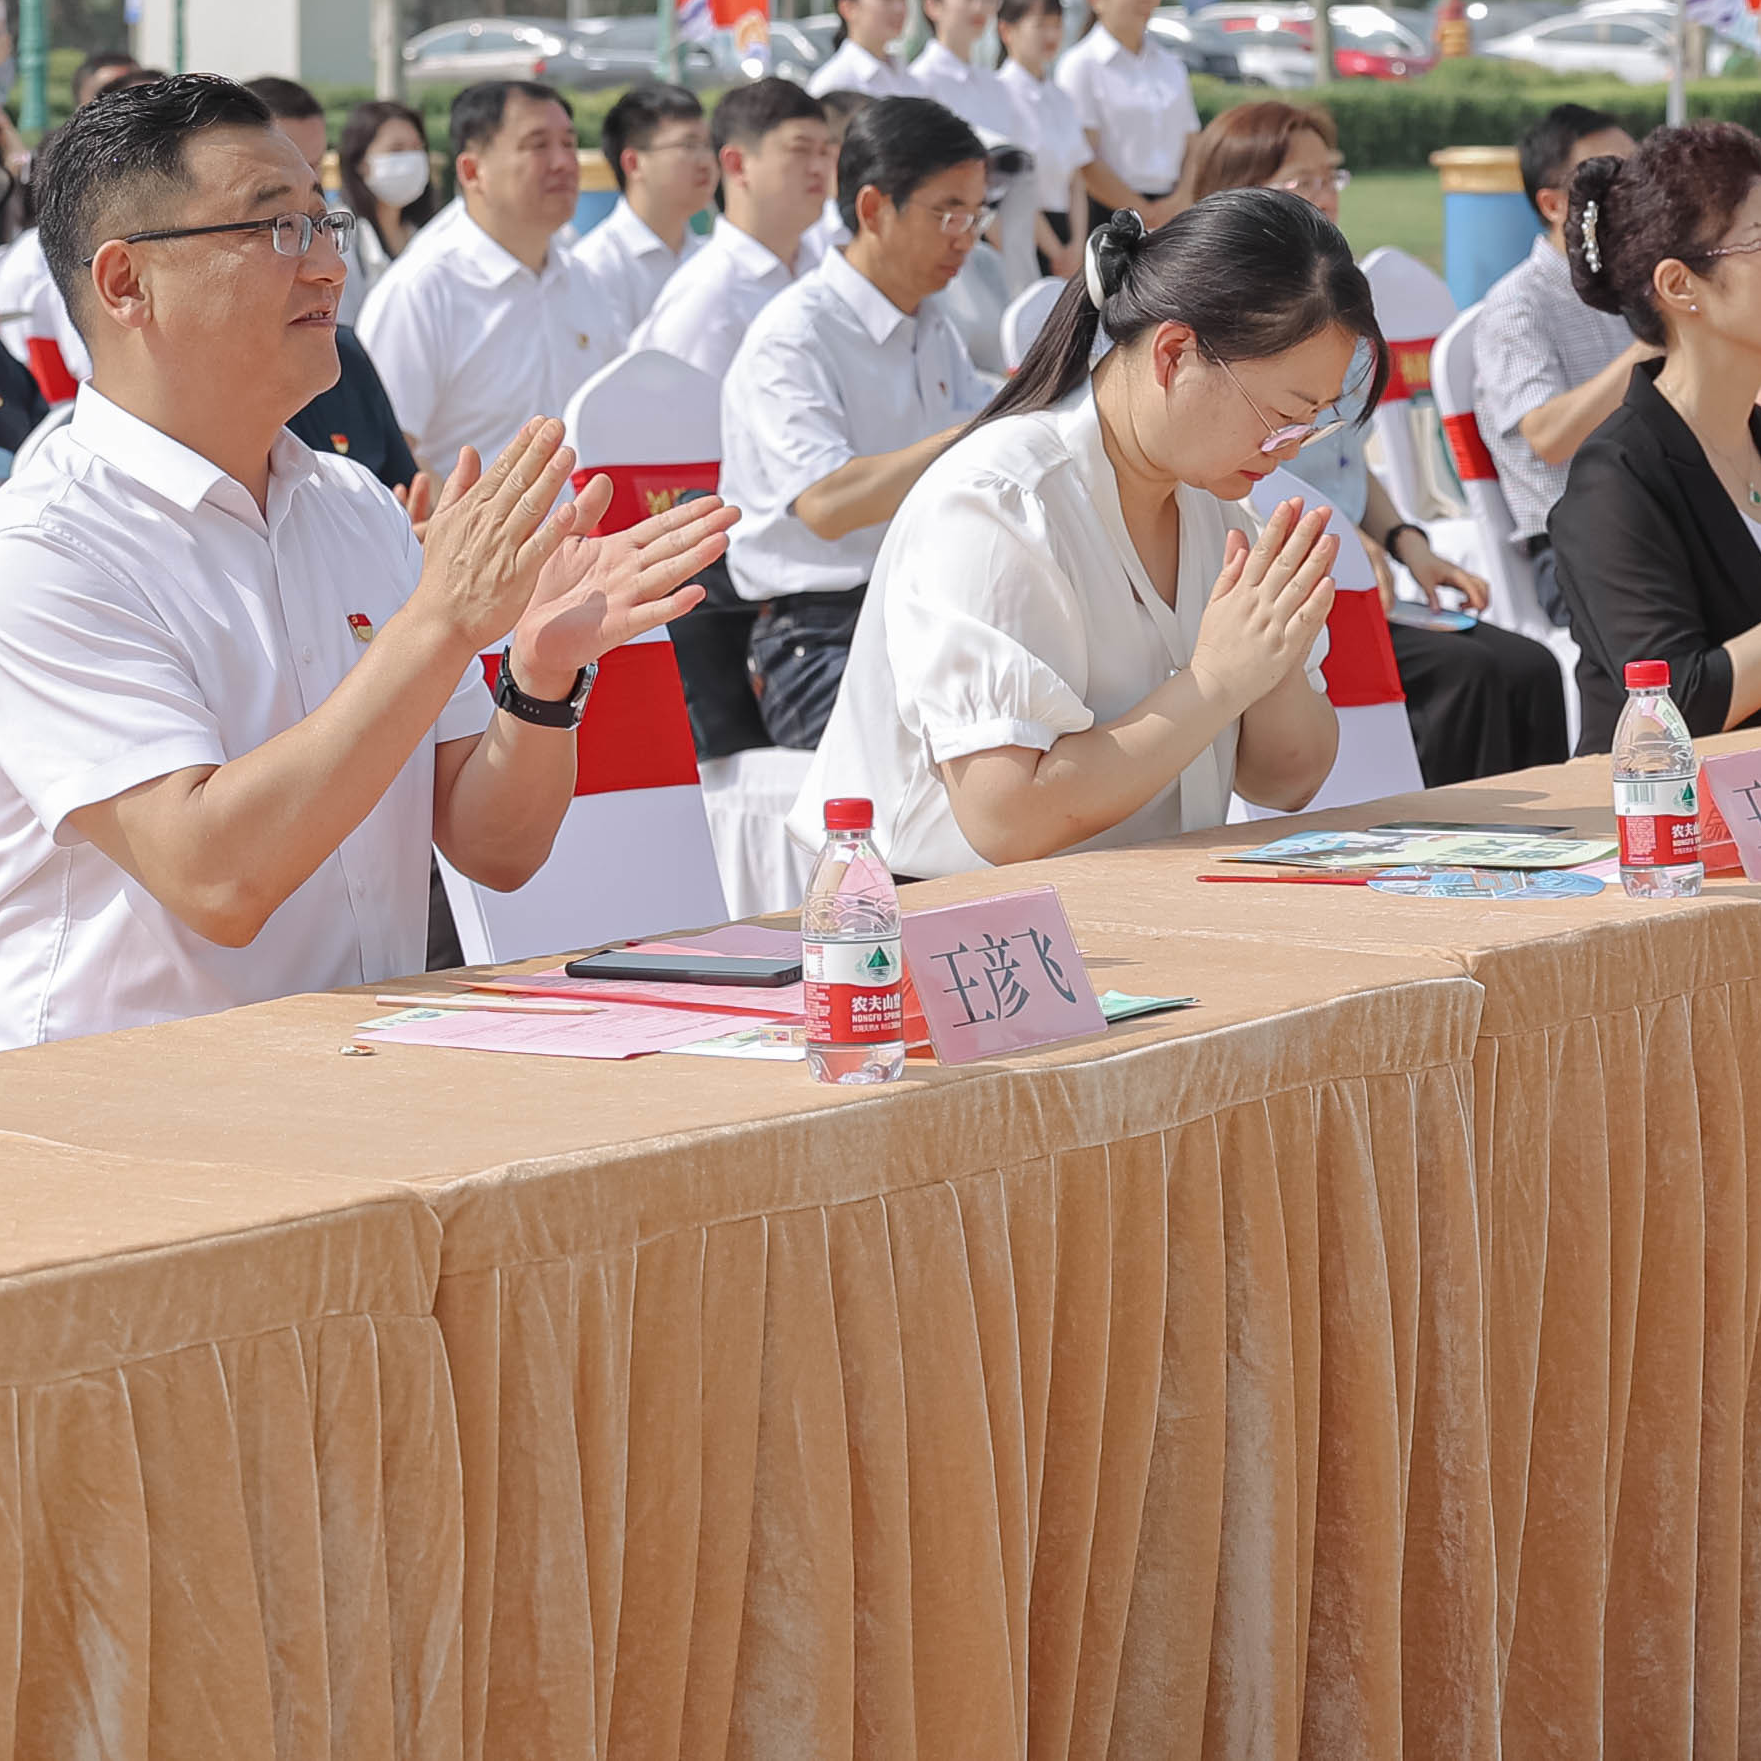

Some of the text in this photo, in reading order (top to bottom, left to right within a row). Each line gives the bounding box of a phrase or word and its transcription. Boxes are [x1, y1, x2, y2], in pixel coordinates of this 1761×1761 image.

[930, 927, 1077, 1029] 王彦飞
[852, 1013, 882, 1023] NONGFU
